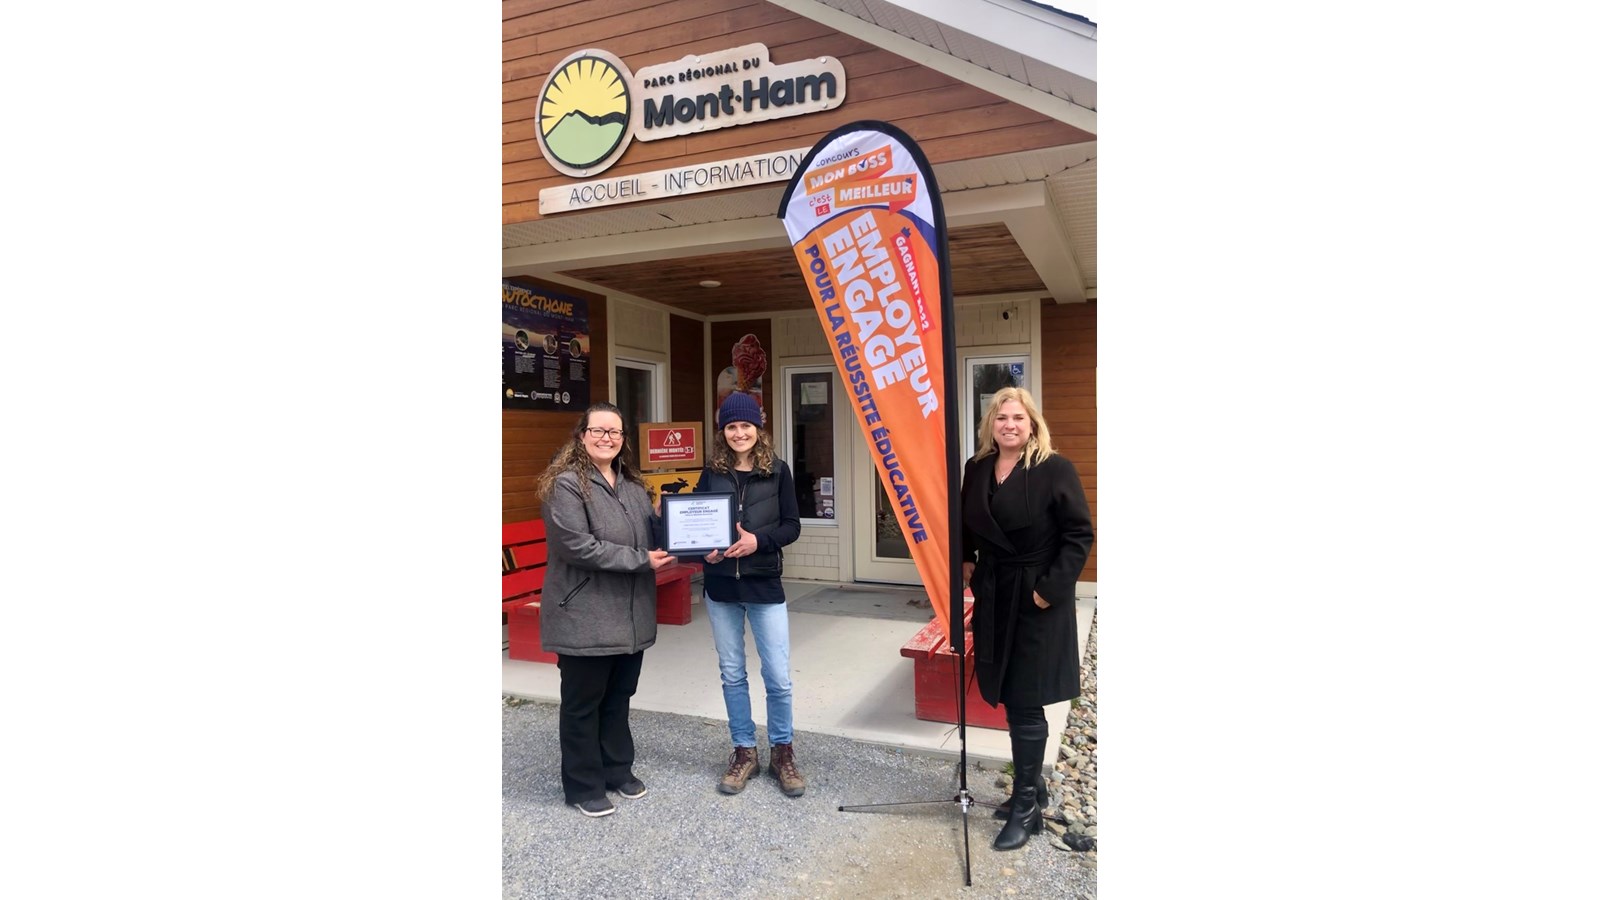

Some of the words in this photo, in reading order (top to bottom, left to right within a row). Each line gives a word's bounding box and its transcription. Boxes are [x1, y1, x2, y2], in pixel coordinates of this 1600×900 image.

[643, 75, 675, 89] PARC
[678, 62, 740, 83] RÉGIONAL
[743, 57, 761, 70] DU
[810, 168, 845, 189] MON
[848, 152, 887, 175] BOSS
[816, 147, 860, 167] concours
[569, 178, 647, 205] ACCUEIL
[664, 152, 804, 191] INFORMATION
[840, 181, 913, 202] MEILLEUR
[809, 193, 833, 207] c'est
[816, 205, 829, 215] LE
[895, 236, 920, 296] GAGNANT
[917, 297, 930, 330] 2022
[850, 211, 939, 419] EMPLOYEUR
[805, 244, 835, 303] POUR
[825, 304, 845, 332] LA
[835, 331, 881, 426] RÉUSSITE
[871, 426, 928, 544] ÉDUCATIVE
